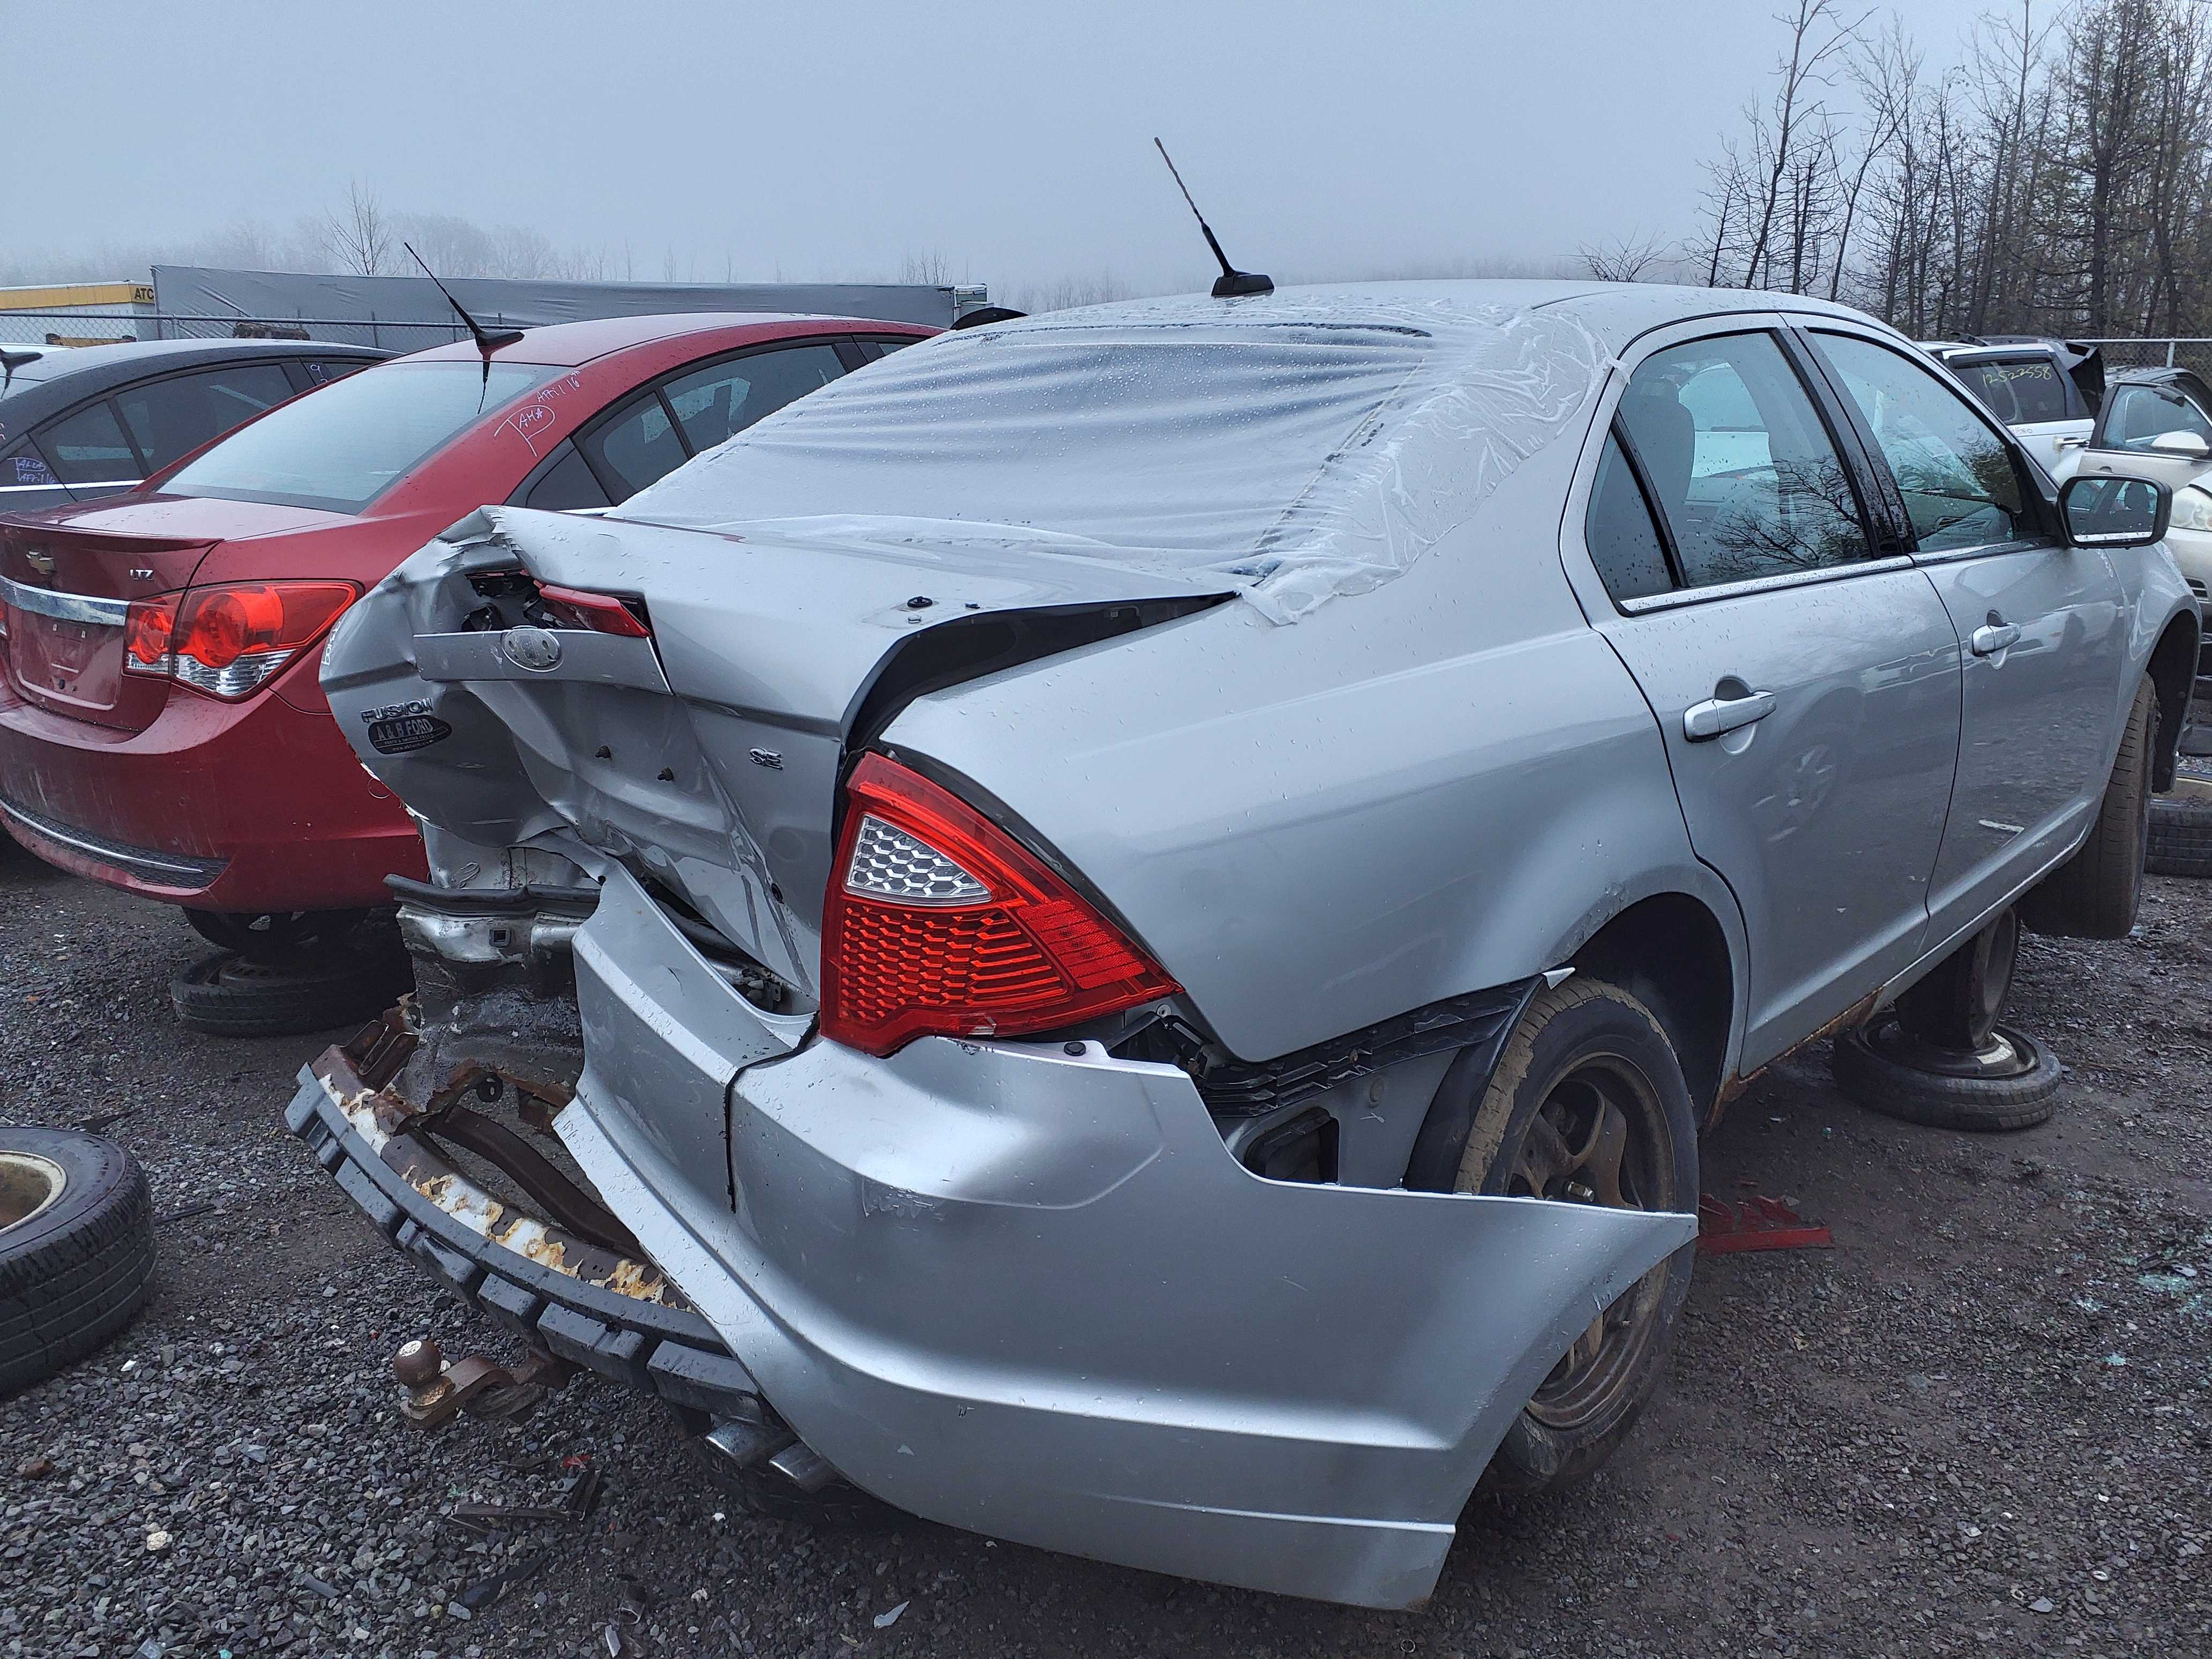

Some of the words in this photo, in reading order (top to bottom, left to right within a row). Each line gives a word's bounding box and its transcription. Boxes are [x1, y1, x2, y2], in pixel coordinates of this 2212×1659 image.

[1983, 366, 2052, 387] 12522558
[130, 569, 154, 581] LTZ
[360, 697, 434, 723] FUSION
[376, 726, 384, 741] A
[385, 724, 395, 739] &
[395, 722, 405, 737] B
[406, 718, 434, 736] FORD
[750, 747, 784, 771] SE
